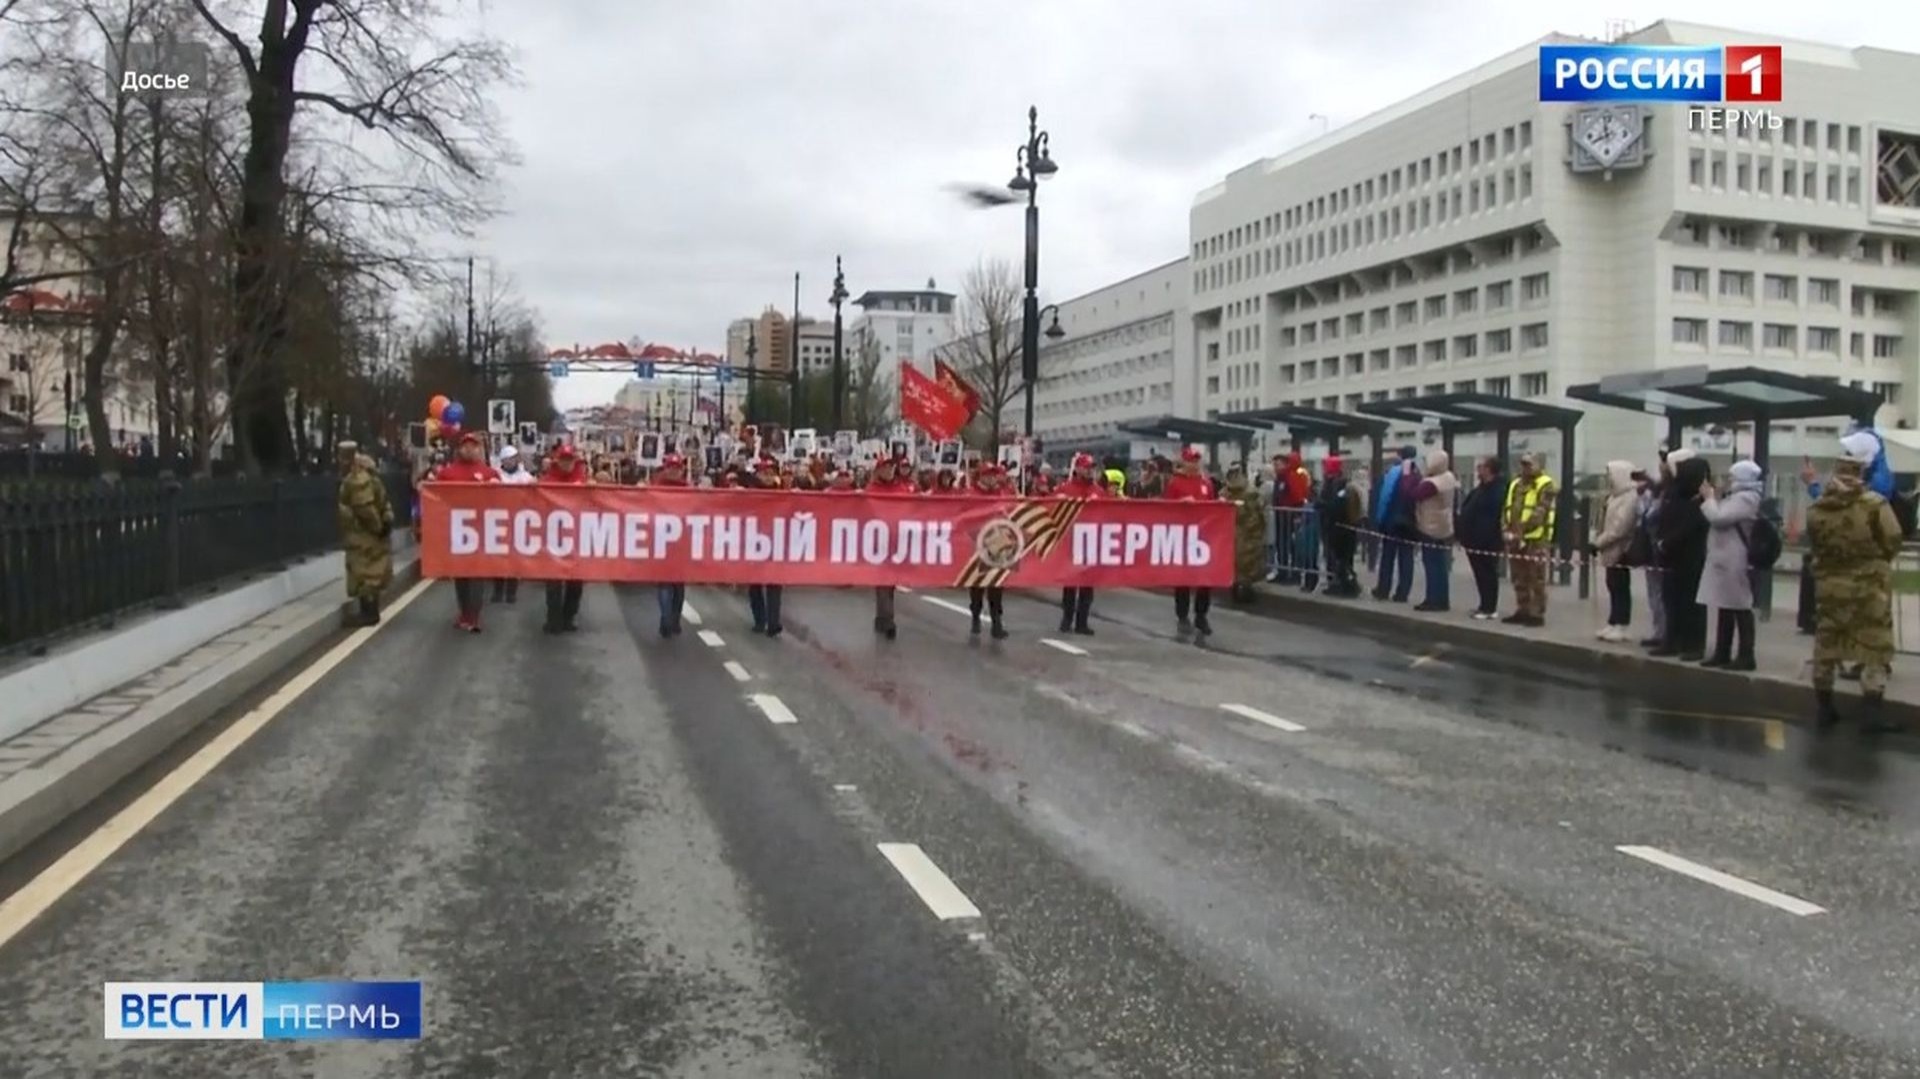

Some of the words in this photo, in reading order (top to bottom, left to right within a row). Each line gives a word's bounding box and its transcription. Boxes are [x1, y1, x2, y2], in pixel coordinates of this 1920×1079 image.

[450, 508, 817, 562] БЕССМЕРТНЫЙ
[830, 517, 953, 565] ПОЛК
[1072, 522, 1211, 566] ПЕРМЬ
